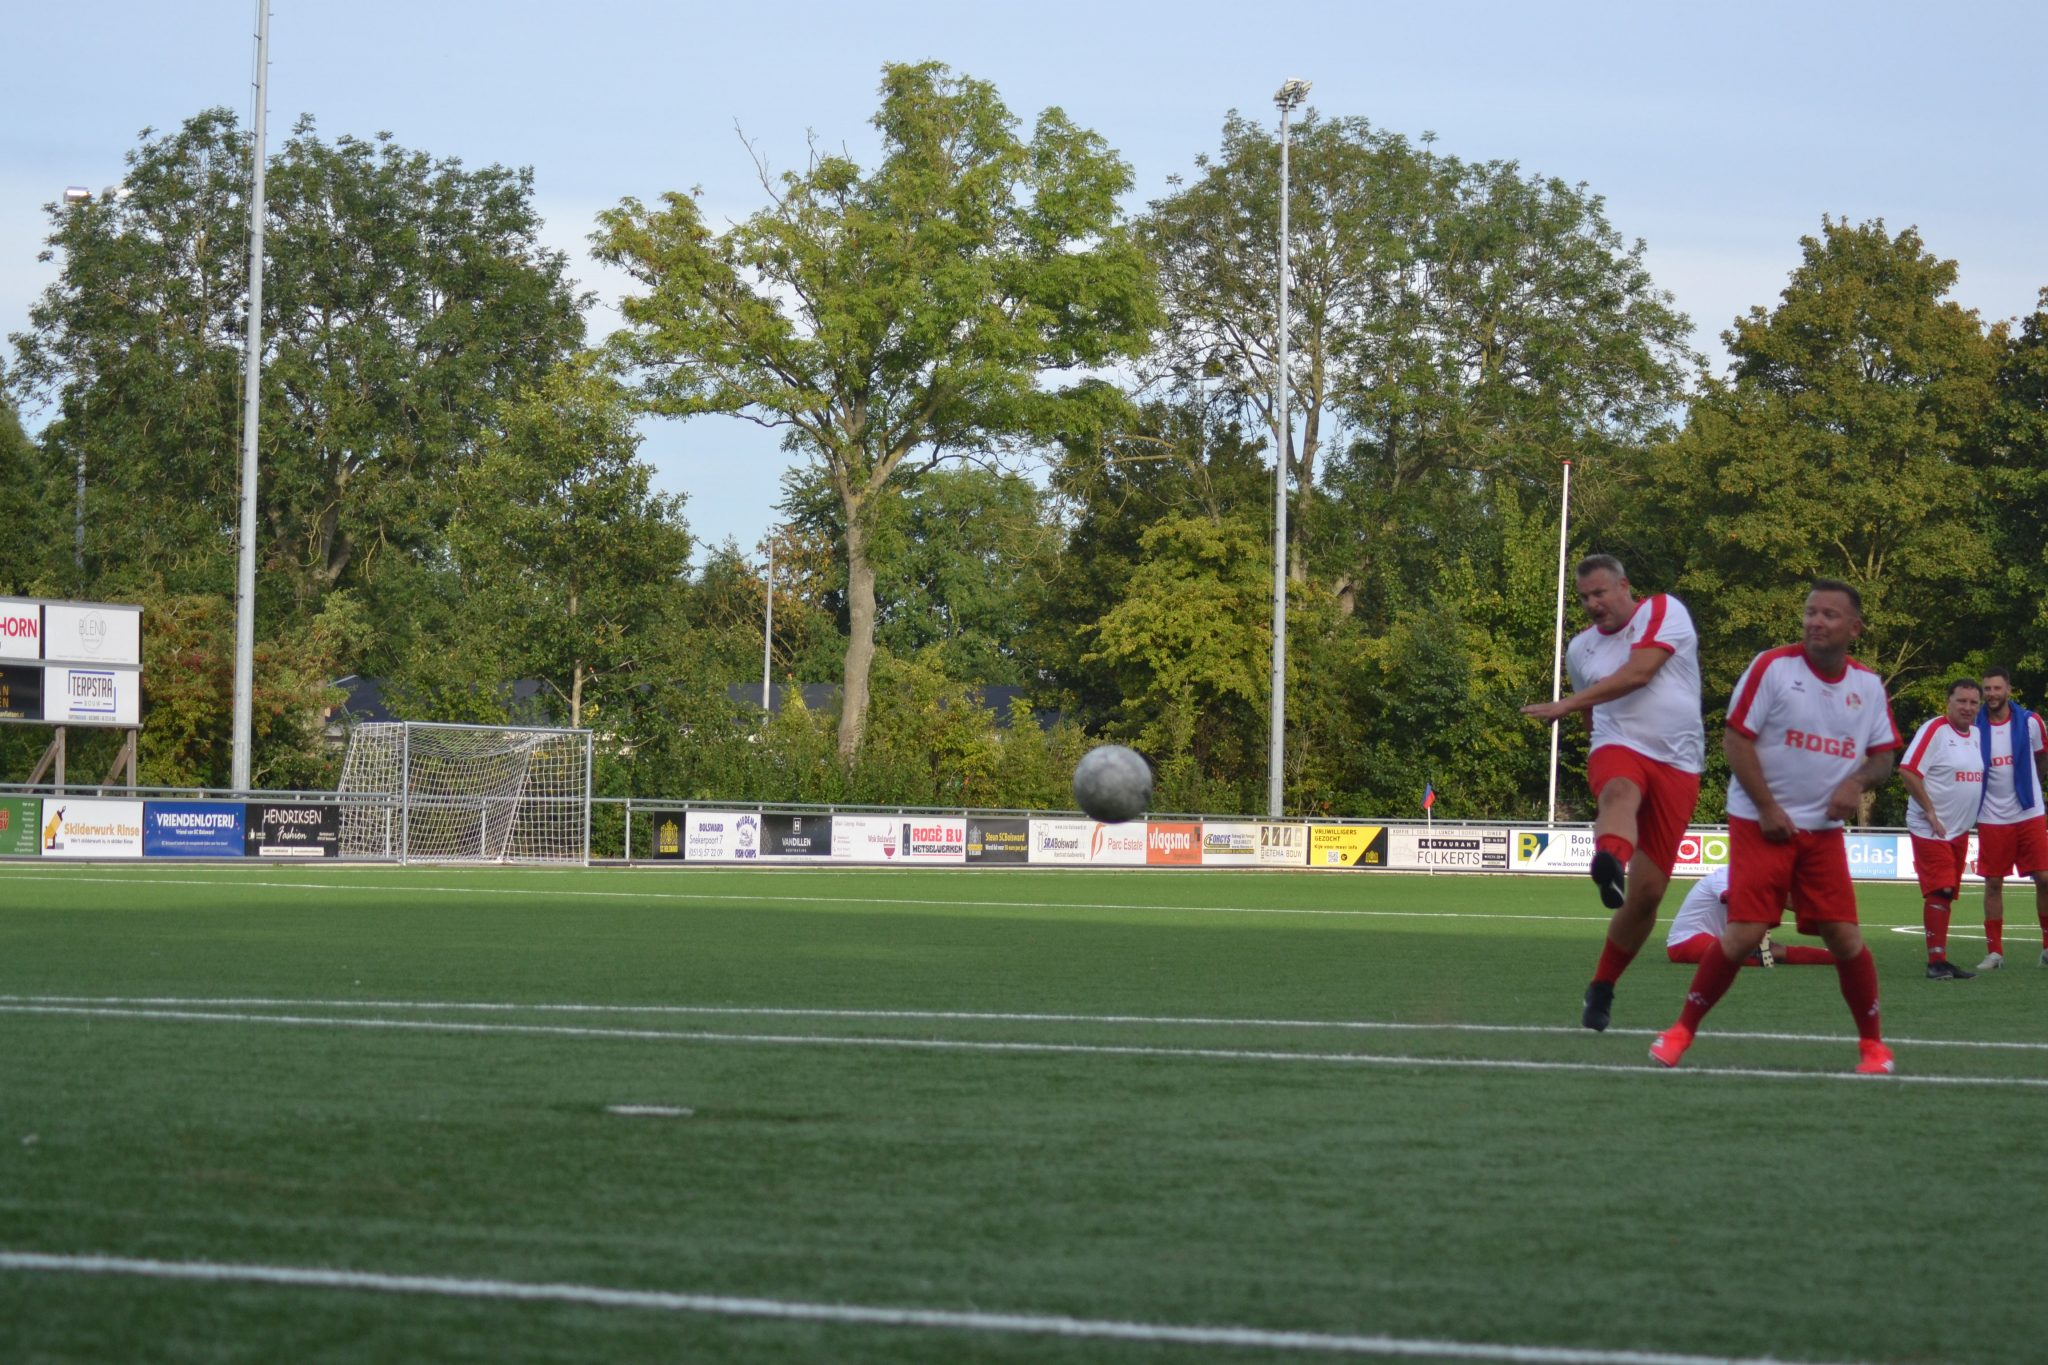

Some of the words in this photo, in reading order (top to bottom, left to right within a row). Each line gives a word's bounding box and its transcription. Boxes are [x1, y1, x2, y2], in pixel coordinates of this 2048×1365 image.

[79, 619, 107, 637] BLEND
[72, 676, 113, 698] TERPSTRA
[156, 813, 235, 828] VRIENDENLOTERIJ
[263, 809, 322, 825] HENDRIKSEN
[117, 825, 140, 837] Rinse
[278, 825, 307, 842] Fashion
[698, 823, 724, 833] BOLSWARD
[1108, 838, 1122, 850] Parc
[1124, 839, 1143, 850] Estate
[1149, 827, 1190, 855] vlagsma
[912, 845, 963, 854] METSELWERKEN
[1286, 850, 1302, 858] BOUW
[1571, 847, 1598, 857] Make
[1848, 843, 1894, 865] Glas
[1417, 851, 1480, 865] FOLKERTS
